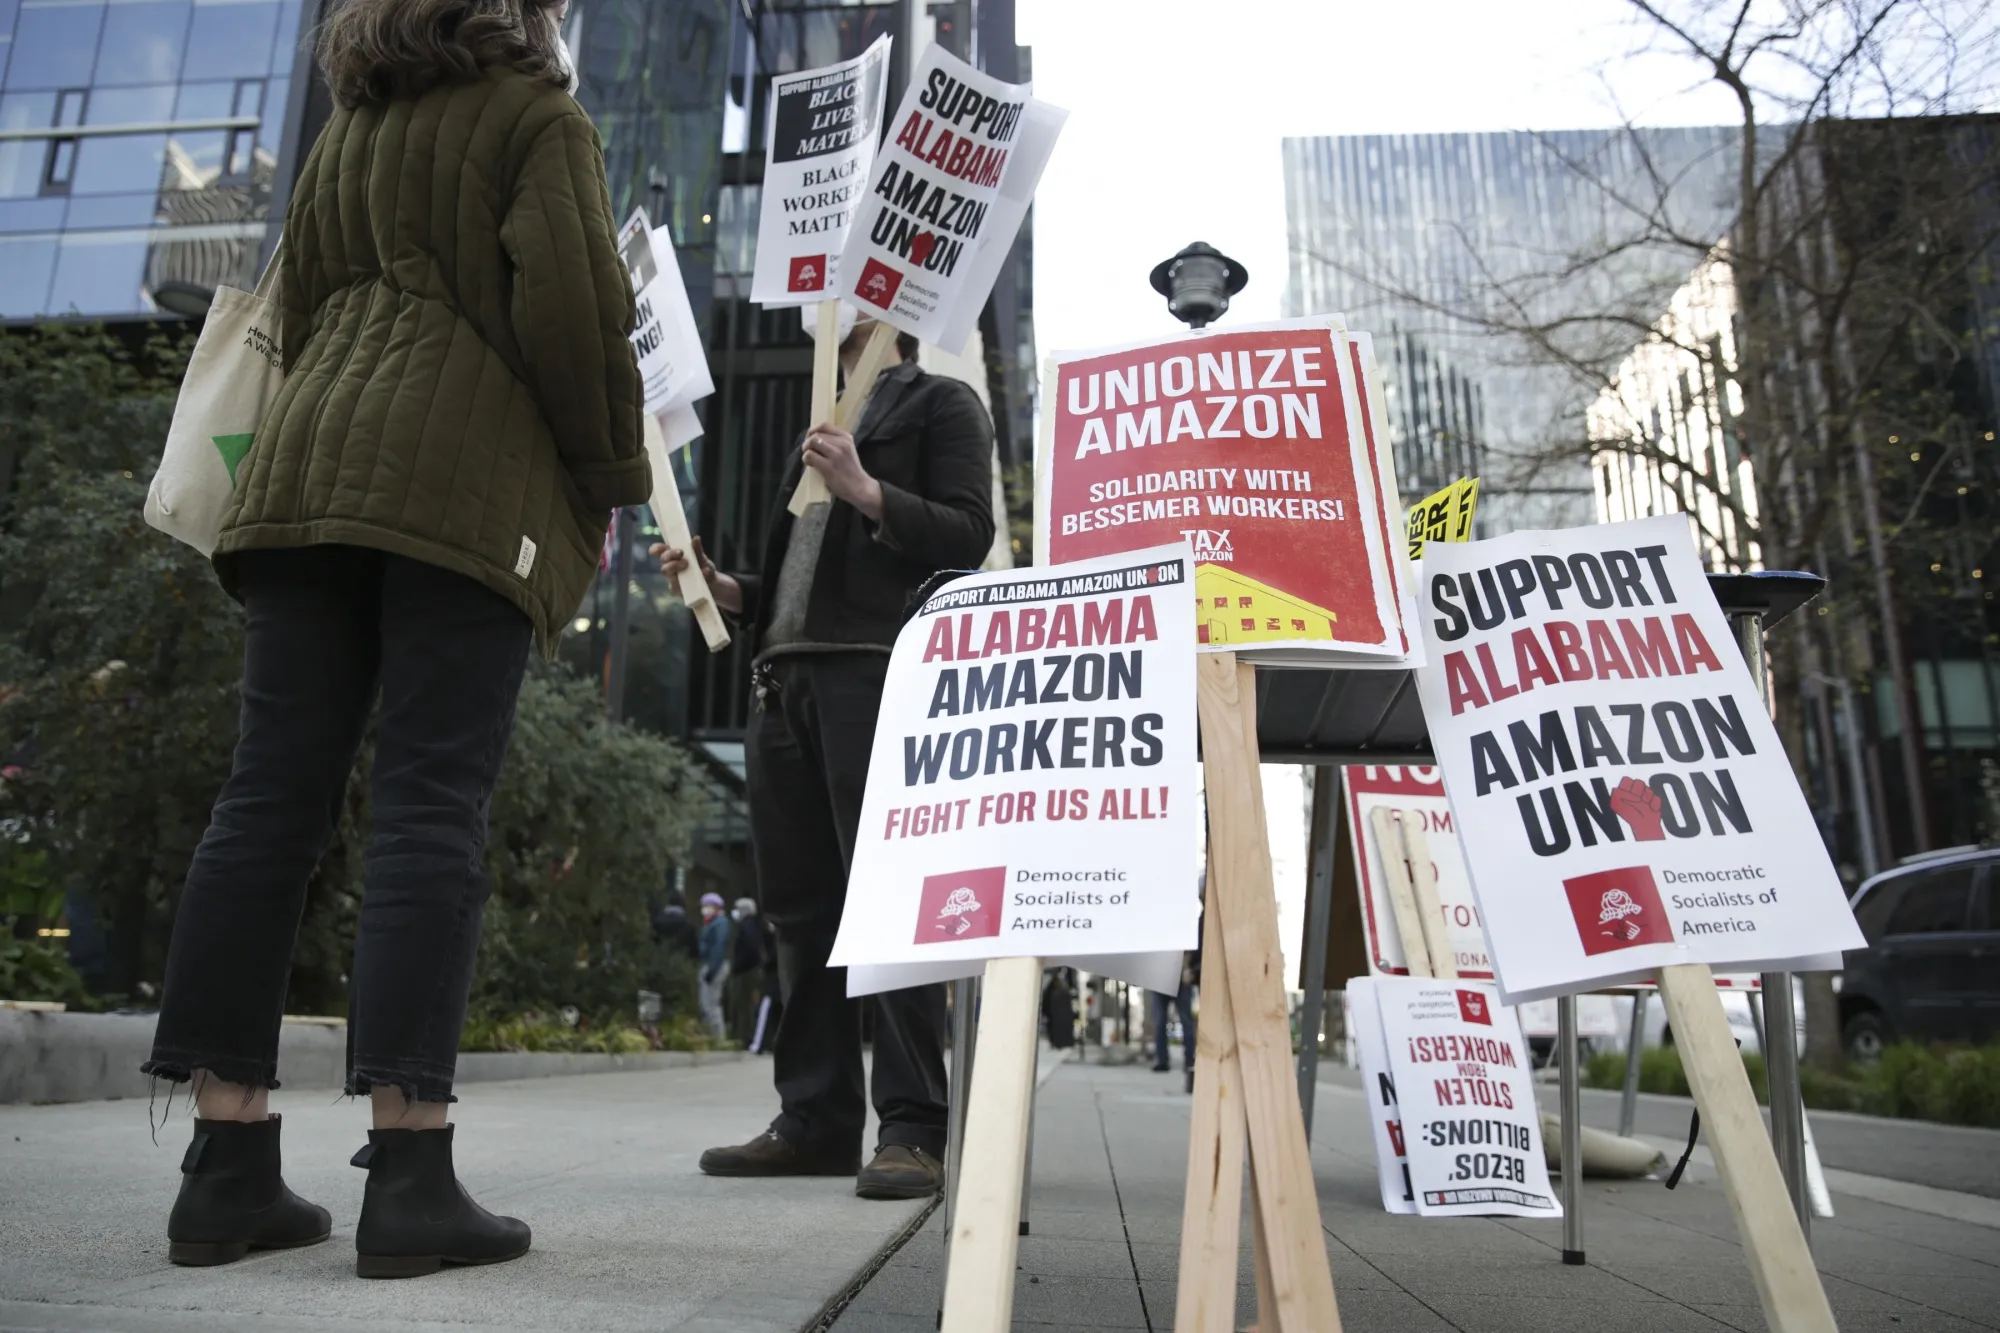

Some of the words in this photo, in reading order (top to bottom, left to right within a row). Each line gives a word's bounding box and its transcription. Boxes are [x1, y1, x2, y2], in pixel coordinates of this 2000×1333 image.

[779, 80, 811, 97] SUPPORT
[808, 79, 864, 109] BLACK
[919, 68, 1025, 143] SUPPORT
[811, 102, 861, 131] LIVES
[796, 119, 868, 156] MATTER
[895, 110, 1008, 188] ALABAMA
[802, 157, 861, 188] BLACK
[874, 160, 989, 239] AMAZON
[870, 206, 964, 278] UNON
[633, 319, 664, 359] NG!
[1067, 347, 1326, 416] UNIONIZE
[1075, 393, 1322, 460] AMAZON
[1089, 468, 1237, 503] SOLIDARITY
[1244, 469, 1312, 493] WITH
[1062, 496, 1201, 536] BESSEMER
[1206, 496, 1344, 521] WORKERS!
[1180, 529, 1234, 551] TAX
[924, 588, 986, 614] SUPPORT
[989, 581, 1058, 601] ALABAMA
[1061, 573, 1123, 596] AMAZON
[1126, 564, 1179, 586] UNON
[1431, 545, 1677, 642] SUPPORT
[922, 595, 1158, 663] ALABAMA
[1443, 613, 1724, 717] ALABAMA
[927, 650, 1142, 719] AMAZON
[903, 713, 1164, 787] WORKERS
[1469, 694, 1756, 797] AMAZON
[884, 799, 970, 840] FIGHT
[978, 791, 1037, 827] FOR
[1046, 789, 1088, 821] US
[1099, 786, 1169, 821] ALL!
[1515, 769, 1753, 857] UNON
[1017, 868, 1127, 883] Democratic
[1662, 865, 1765, 885] Democratic
[1014, 891, 1103, 906] Socialists
[1109, 890, 1130, 905] of
[1672, 890, 1754, 910] Socialists
[1759, 888, 1778, 905] of
[1011, 915, 1092, 930] America
[1681, 918, 1756, 936] America
[1408, 1035, 1517, 1068] WORKERS!
[1457, 1063, 1488, 1078] FROM
[1434, 1078, 1514, 1110] STOLEN
[1422, 1119, 1531, 1152] BILLIONS:
